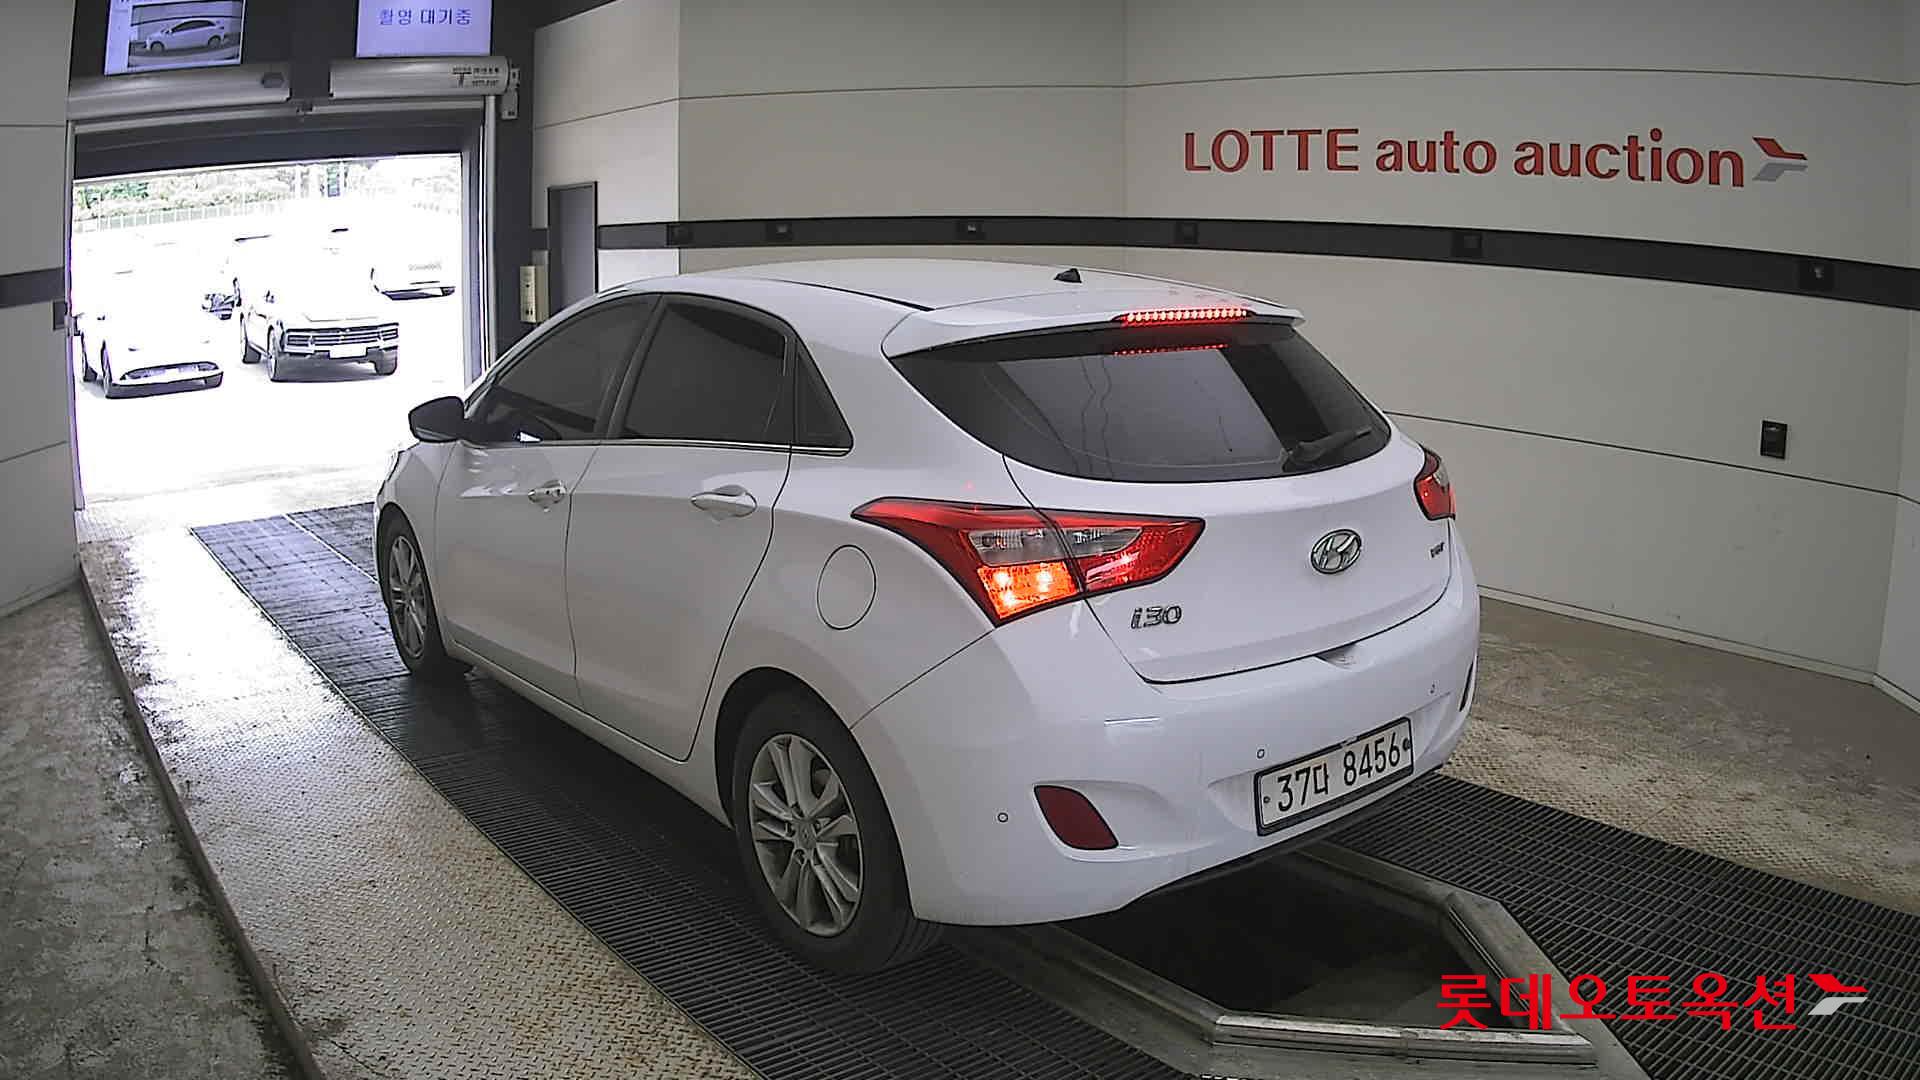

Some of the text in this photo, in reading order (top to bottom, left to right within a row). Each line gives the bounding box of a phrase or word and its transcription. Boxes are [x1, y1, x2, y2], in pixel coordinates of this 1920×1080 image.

[420, 8, 473, 26] 대기중
[1184, 128, 1744, 188] LOTTE auto auction
[1130, 605, 1182, 629] i30
[1343, 732, 1400, 786] 8456
